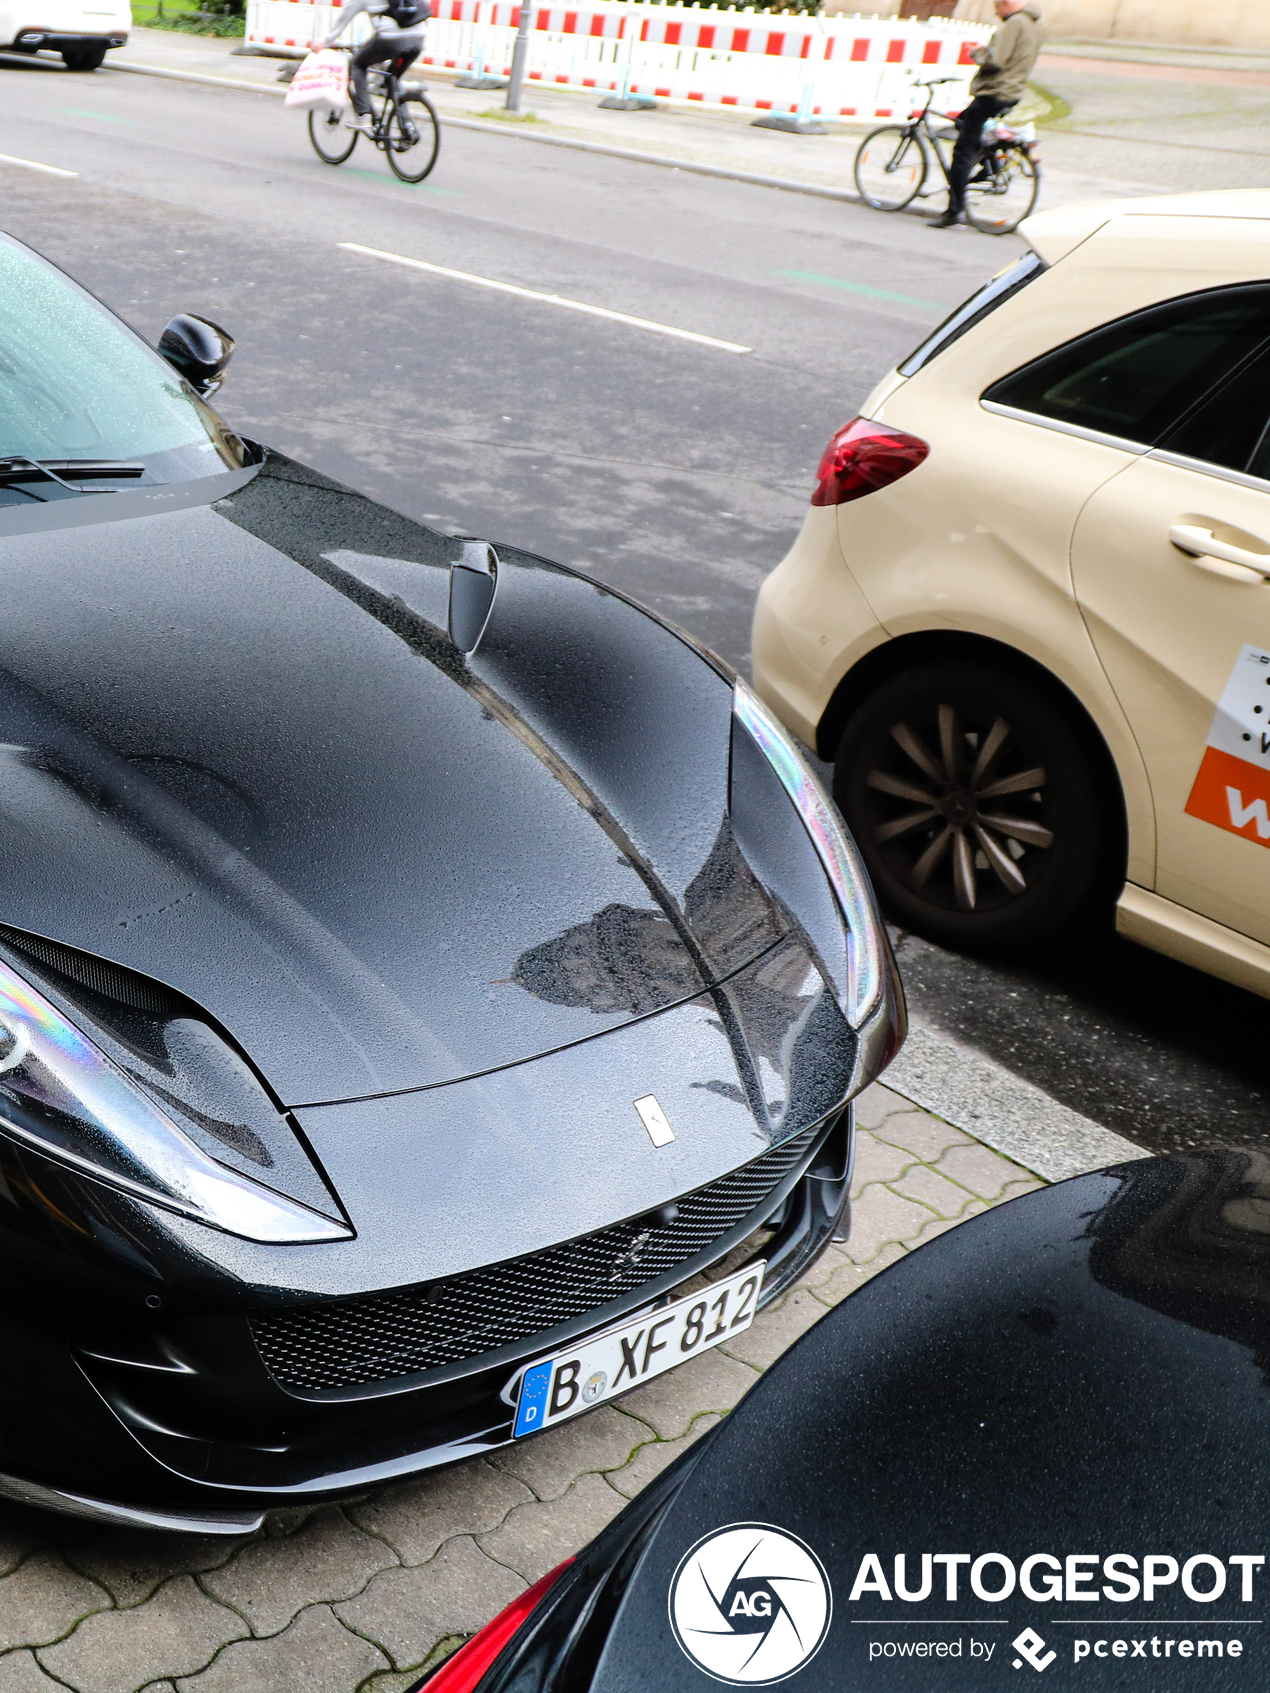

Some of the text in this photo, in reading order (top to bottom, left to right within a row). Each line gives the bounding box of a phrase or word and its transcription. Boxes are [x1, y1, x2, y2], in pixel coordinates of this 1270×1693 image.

[548, 1274, 759, 1418] B XF 812
[524, 1405, 538, 1423] D
